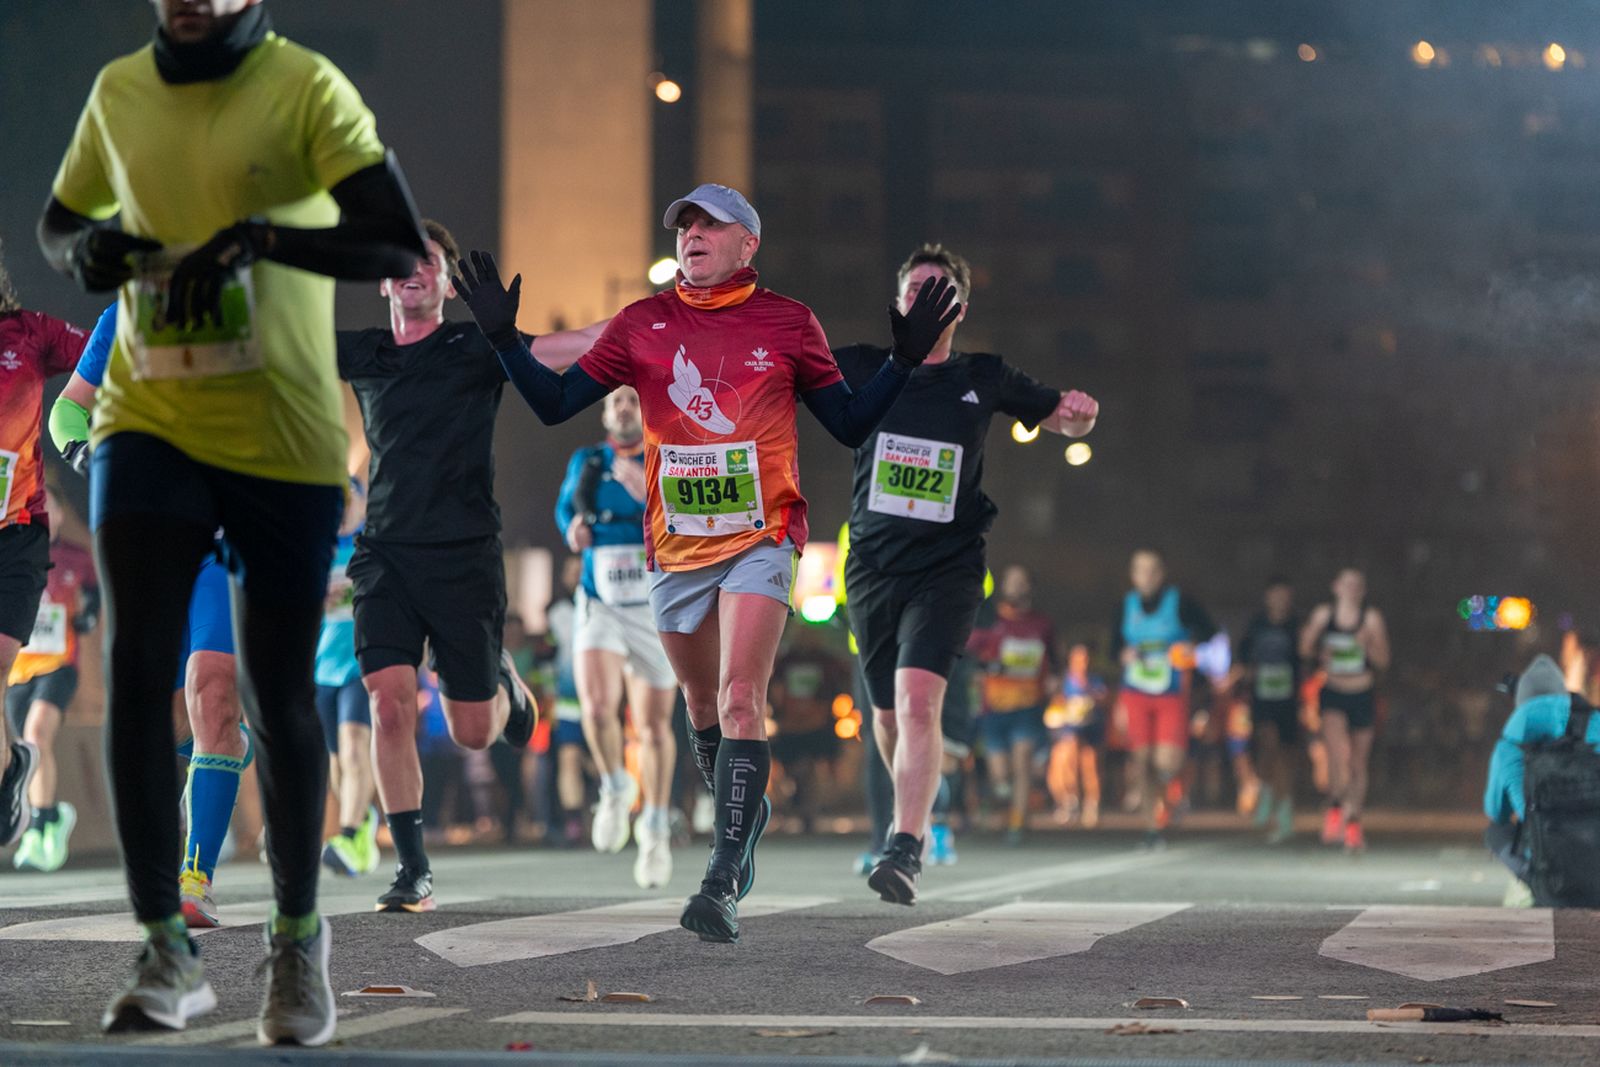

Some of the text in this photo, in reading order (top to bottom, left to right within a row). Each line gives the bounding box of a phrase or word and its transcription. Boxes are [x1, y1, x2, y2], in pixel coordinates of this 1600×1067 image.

[686, 395, 713, 420] 43
[678, 455, 717, 466] NOCHE DE
[885, 453, 901, 462] SAN
[896, 445, 919, 455] NOCHE
[921, 447, 931, 457] DE
[668, 466, 685, 477] SAN
[686, 464, 718, 477] ANTÓN
[888, 463, 944, 494] 3022
[677, 477, 740, 505] 9134
[725, 757, 757, 842] kalenji
